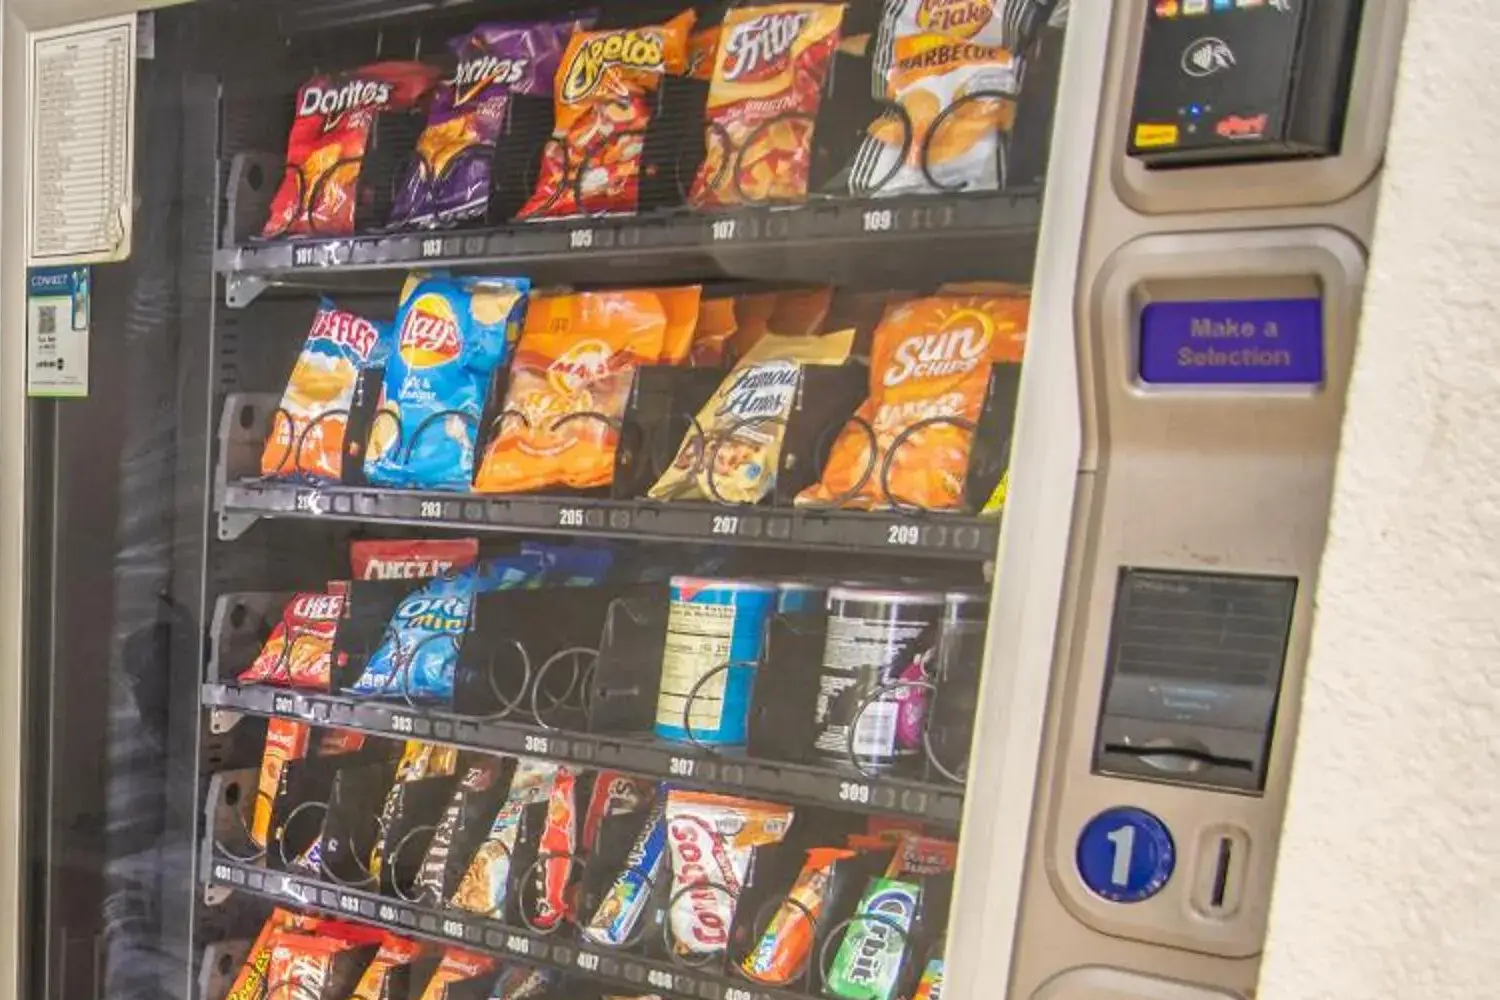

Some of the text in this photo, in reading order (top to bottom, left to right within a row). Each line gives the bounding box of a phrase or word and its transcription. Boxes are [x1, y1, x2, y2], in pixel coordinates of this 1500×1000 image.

[299, 79, 395, 116] Doritos
[712, 220, 736, 240] 107
[864, 210, 891, 231] 109
[570, 230, 593, 247] 105
[1190, 317, 1279, 338] Make a
[884, 327, 987, 387] Sun
[1177, 346, 1291, 367] Selection
[421, 501, 442, 518] 203
[560, 509, 583, 526] 205
[713, 517, 739, 534] 207
[888, 525, 919, 545] 209
[391, 715, 413, 732] 303
[525, 735, 549, 753] 305
[670, 757, 695, 776] 307
[839, 782, 870, 803] 309
[1106, 824, 1136, 887] 1
[443, 919, 464, 937] 405
[577, 952, 600, 971] 407
